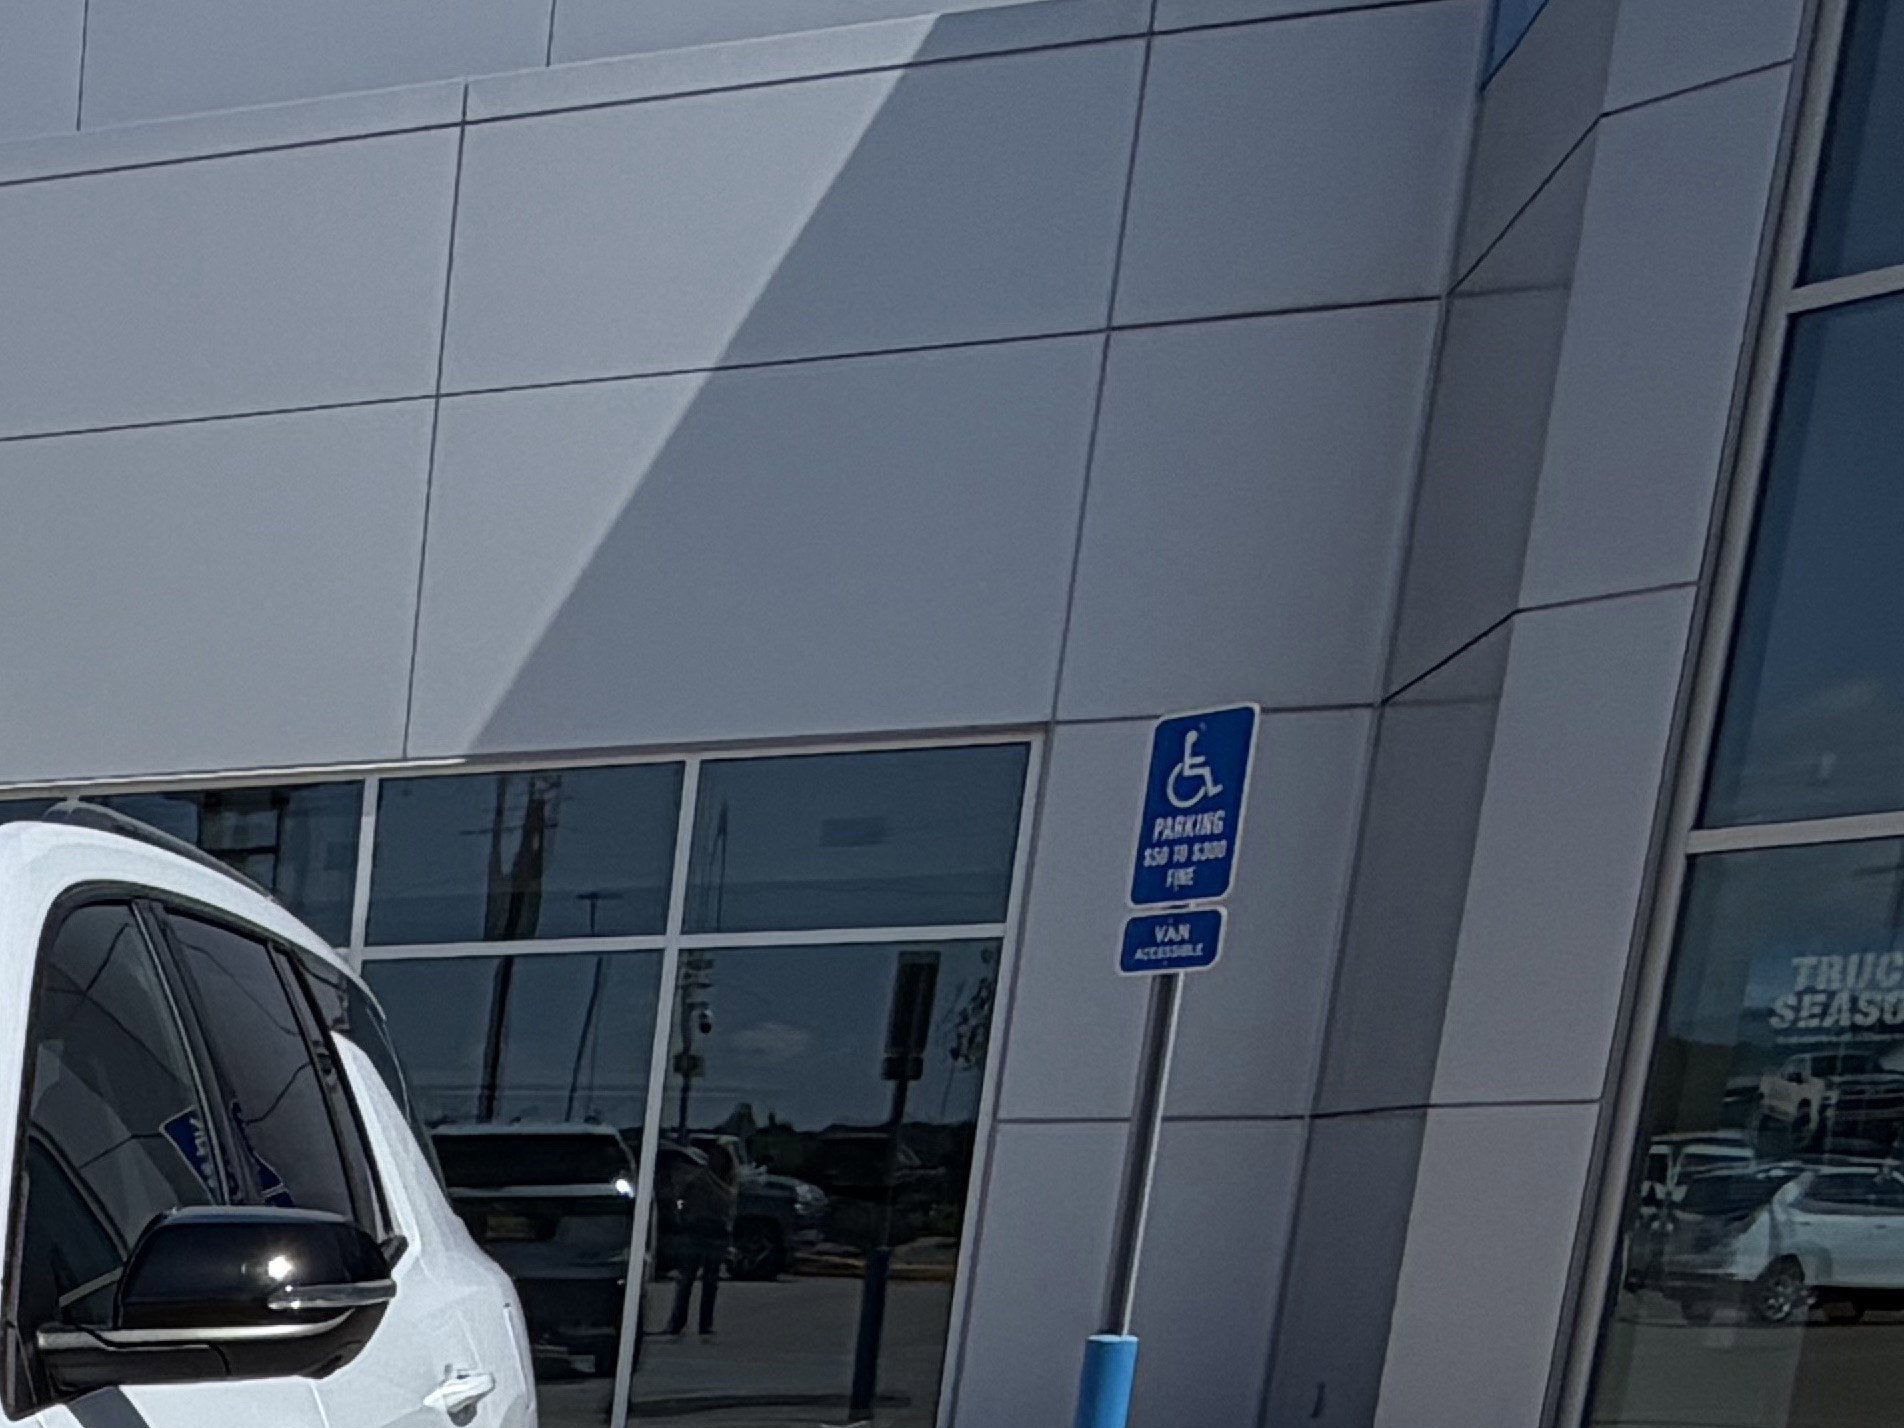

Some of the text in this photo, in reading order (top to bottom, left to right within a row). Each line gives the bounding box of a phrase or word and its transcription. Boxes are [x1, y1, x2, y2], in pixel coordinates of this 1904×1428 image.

[1153, 810, 1225, 843] PARKING
[1143, 846, 1169, 867] $50
[1173, 844, 1188, 863] TO
[1166, 866, 1195, 887] FINE
[1155, 924, 1191, 943] VAN
[1135, 943, 1203, 960] ACCESSIBLE
